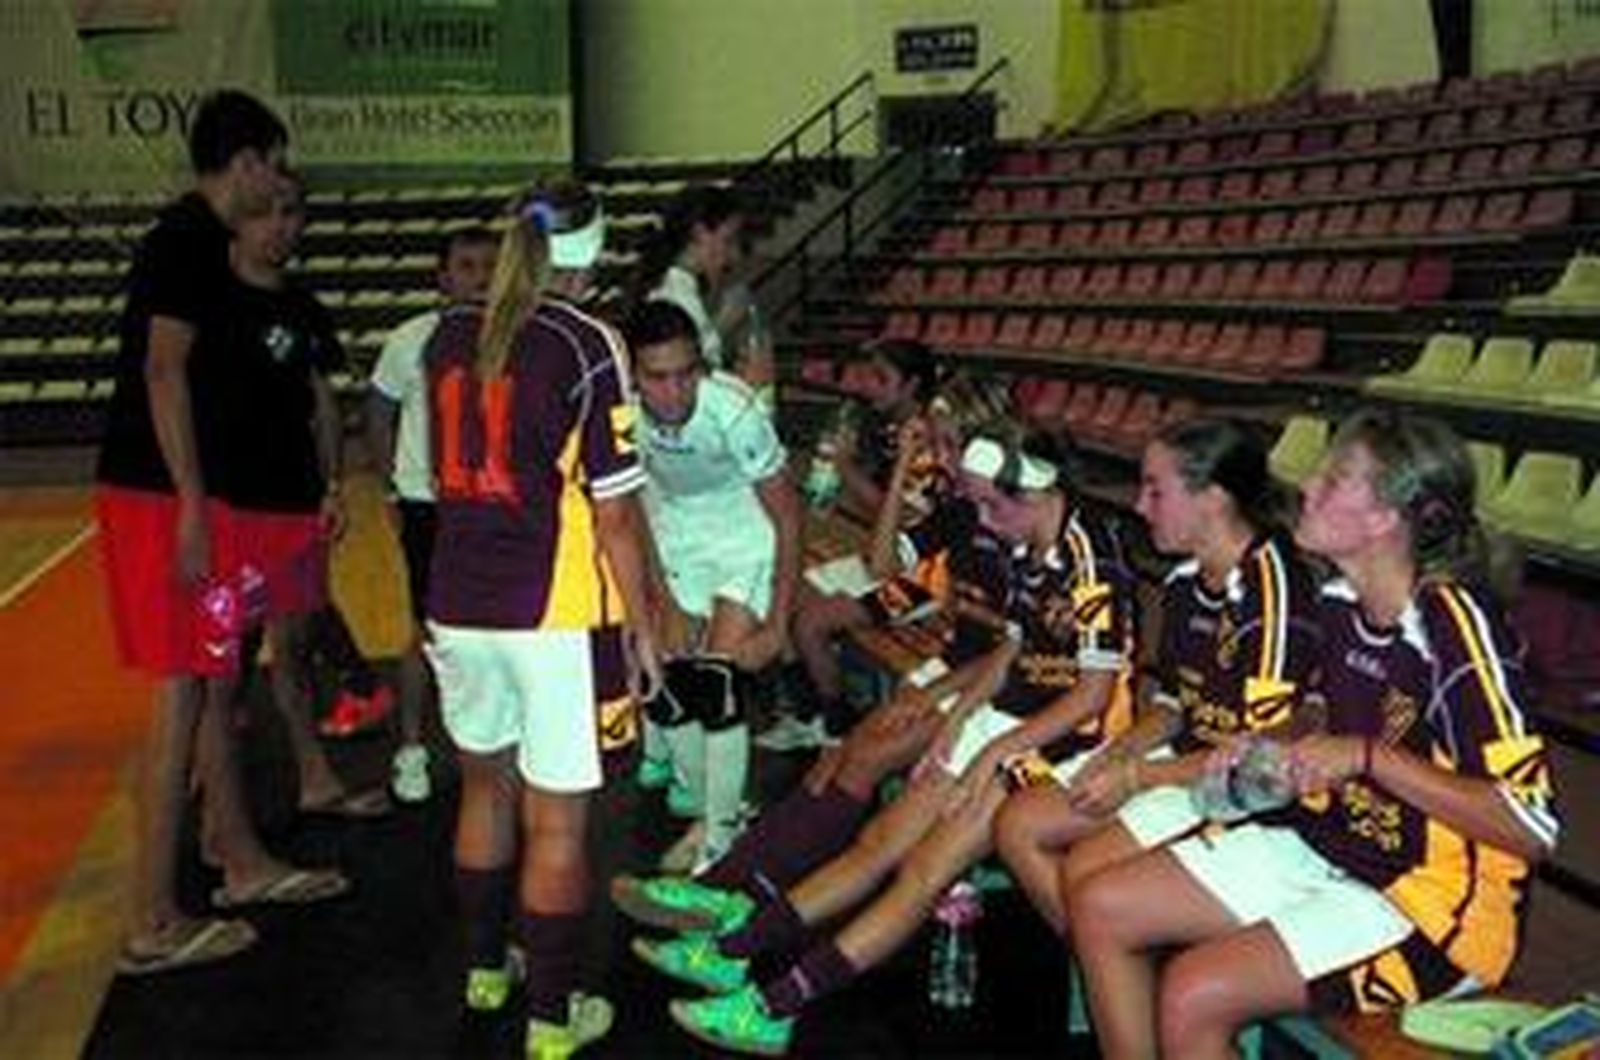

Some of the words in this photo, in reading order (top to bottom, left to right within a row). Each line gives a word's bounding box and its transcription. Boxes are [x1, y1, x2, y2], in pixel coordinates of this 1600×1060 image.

[27, 89, 81, 137] EL
[92, 89, 198, 138] TOY
[434, 366, 520, 504] 11
